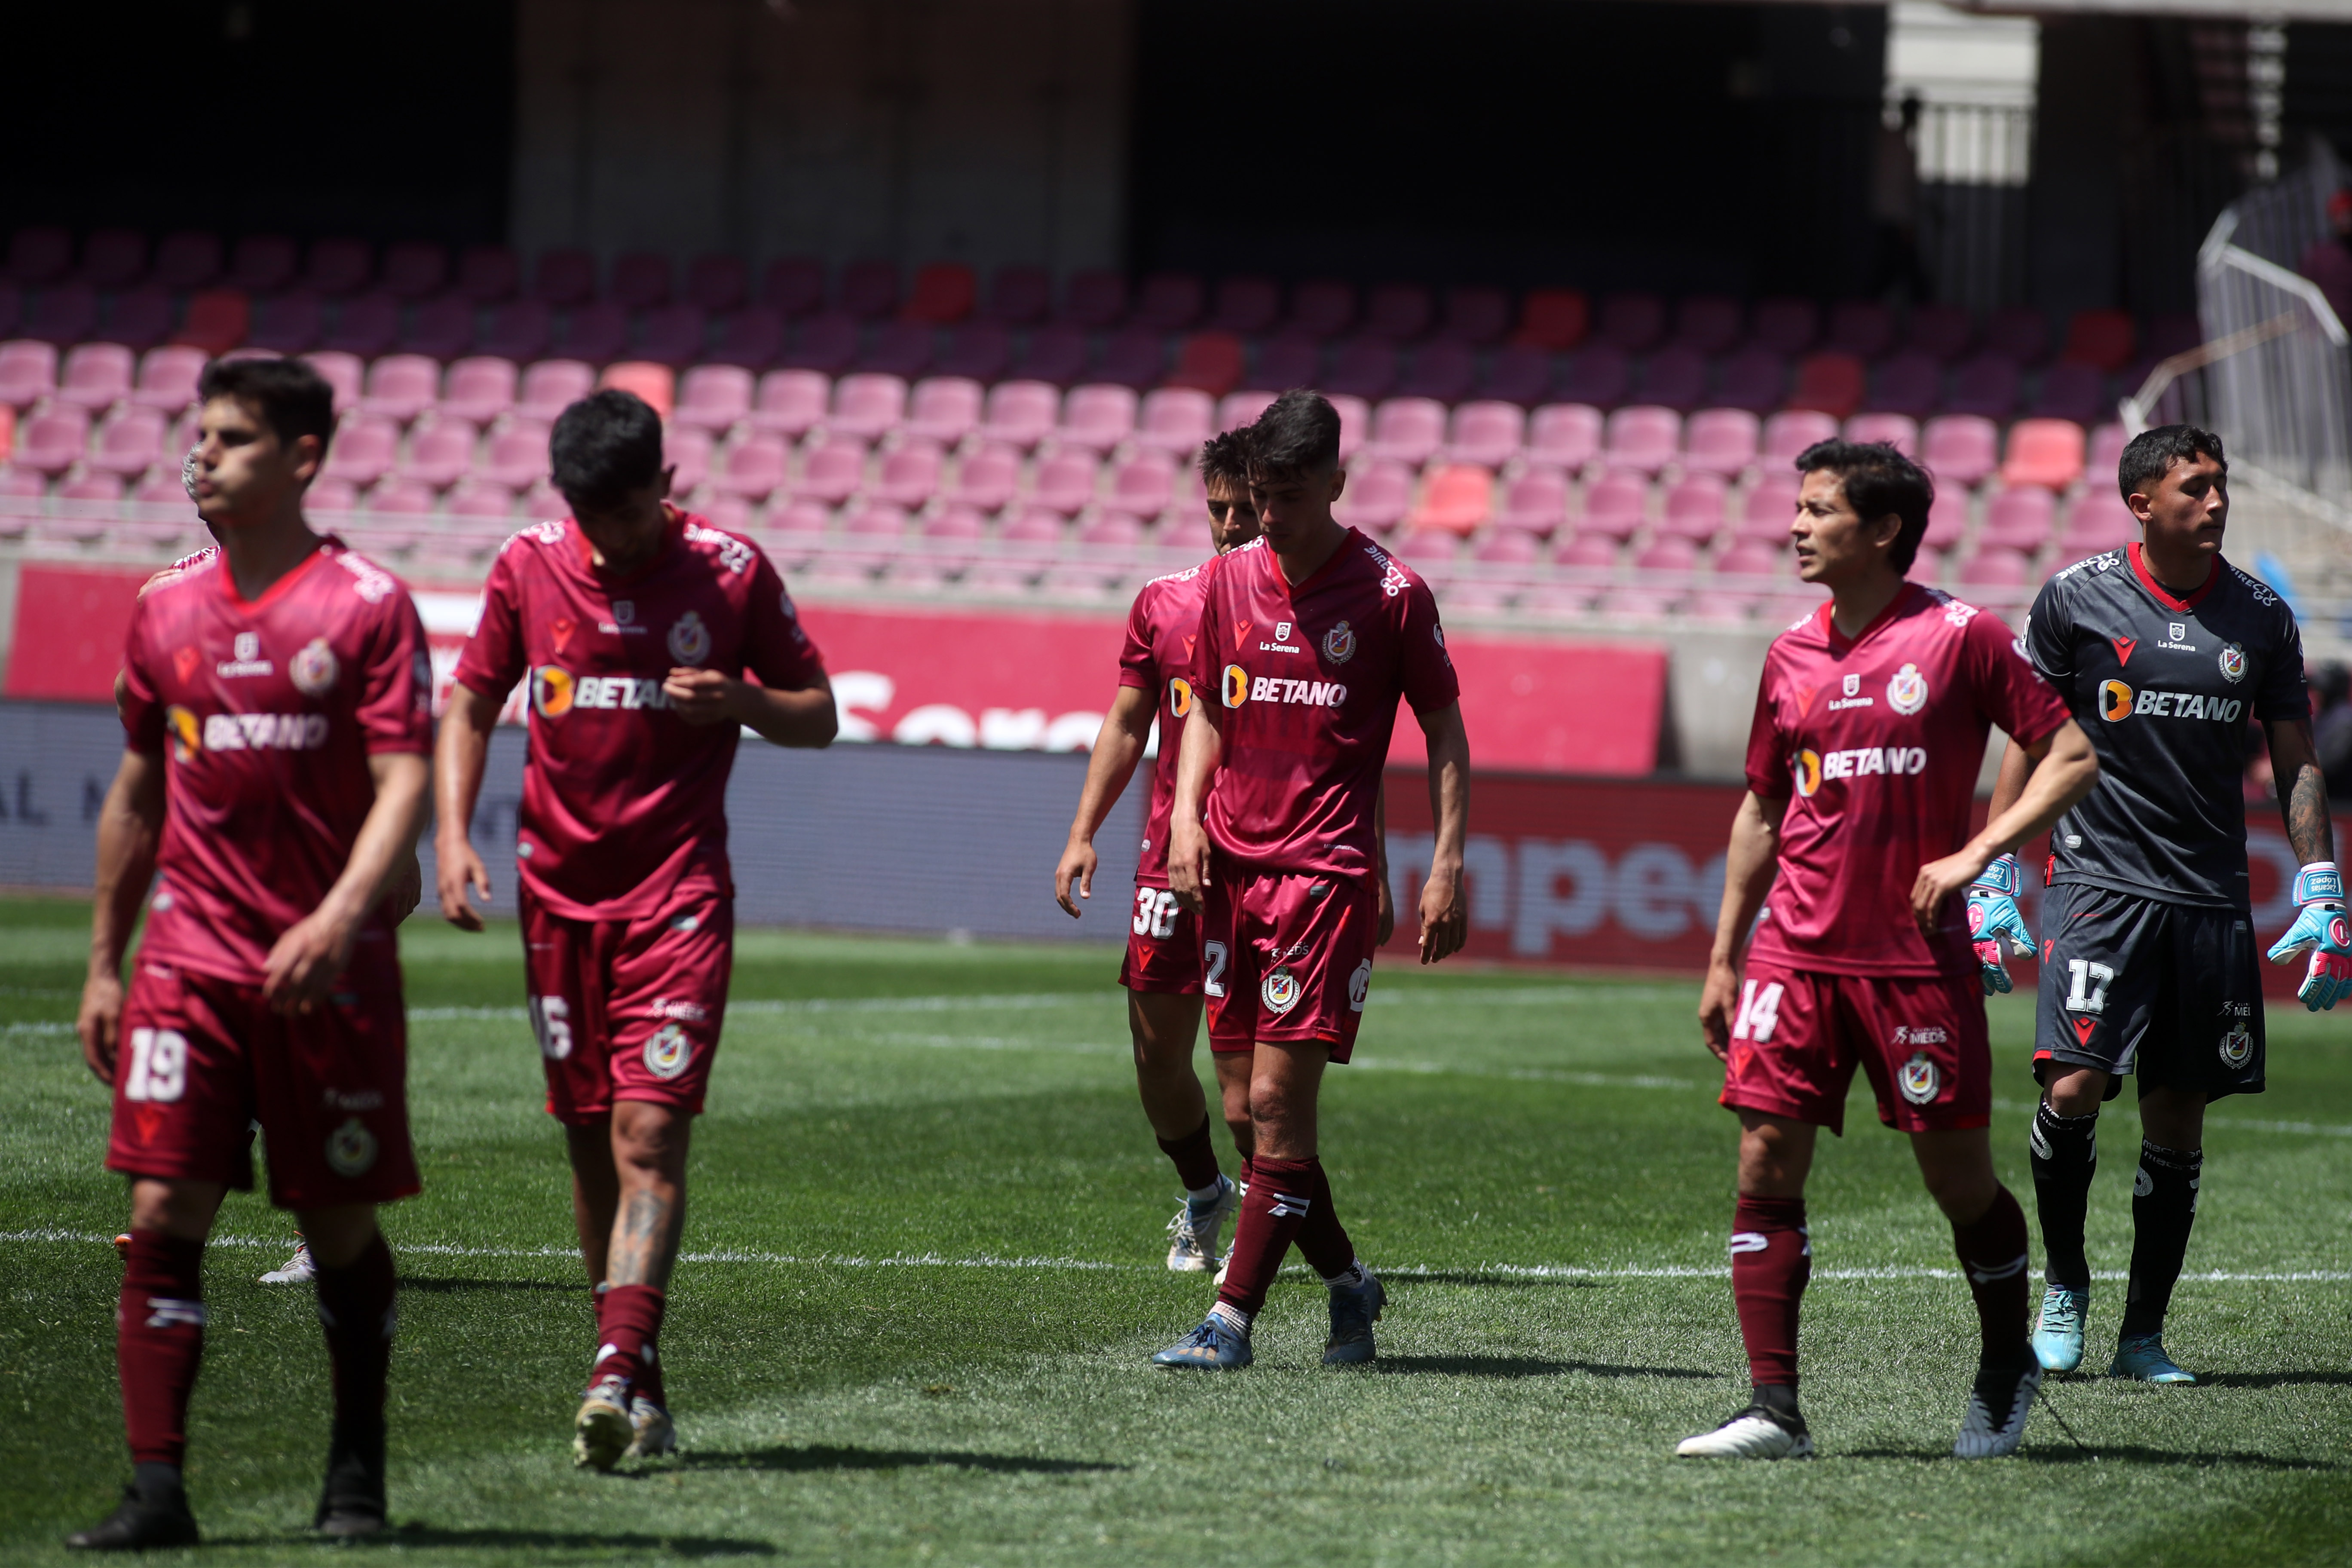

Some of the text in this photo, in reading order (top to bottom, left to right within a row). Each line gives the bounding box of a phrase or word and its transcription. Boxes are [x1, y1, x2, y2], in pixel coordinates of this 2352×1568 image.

[1363, 545, 1411, 588] DIRECTV
[2055, 551, 2113, 580] DIRECTV
[2097, 557, 2119, 572] GO
[1380, 577, 1399, 597] GO
[2253, 591, 2272, 606] GO
[1259, 642, 1300, 654] La Serena
[2158, 640, 2196, 652] La Serena
[1250, 677, 1348, 707] BETANO
[2134, 689, 2242, 723] BETANO
[203, 712, 328, 752] BETANO
[1823, 747, 1927, 781] BETANO
[1133, 887, 1179, 939] 30
[2066, 959, 2114, 1014] 17
[1733, 979, 1784, 1043] 14
[1909, 1031, 1948, 1045] MEDS
[125, 1027, 188, 1102] 19
